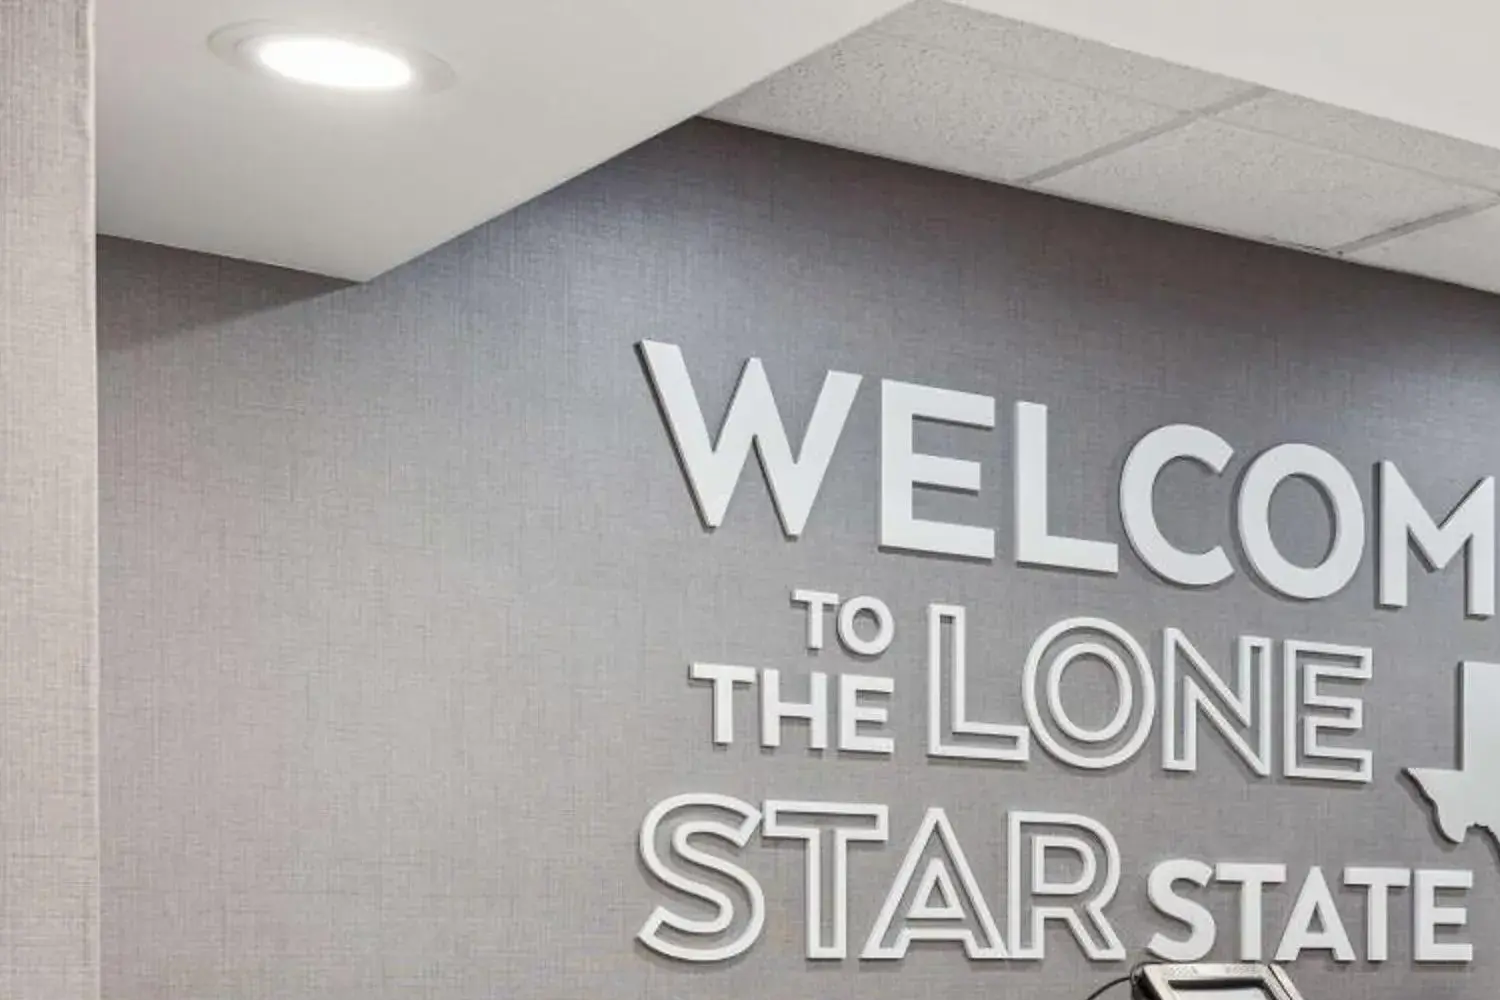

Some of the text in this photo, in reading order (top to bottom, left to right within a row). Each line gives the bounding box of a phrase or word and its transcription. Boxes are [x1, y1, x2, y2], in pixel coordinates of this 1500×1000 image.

[689, 604, 1373, 783] THE LONE
[791, 589, 895, 657] TO
[637, 793, 1474, 962] STAR STATE
